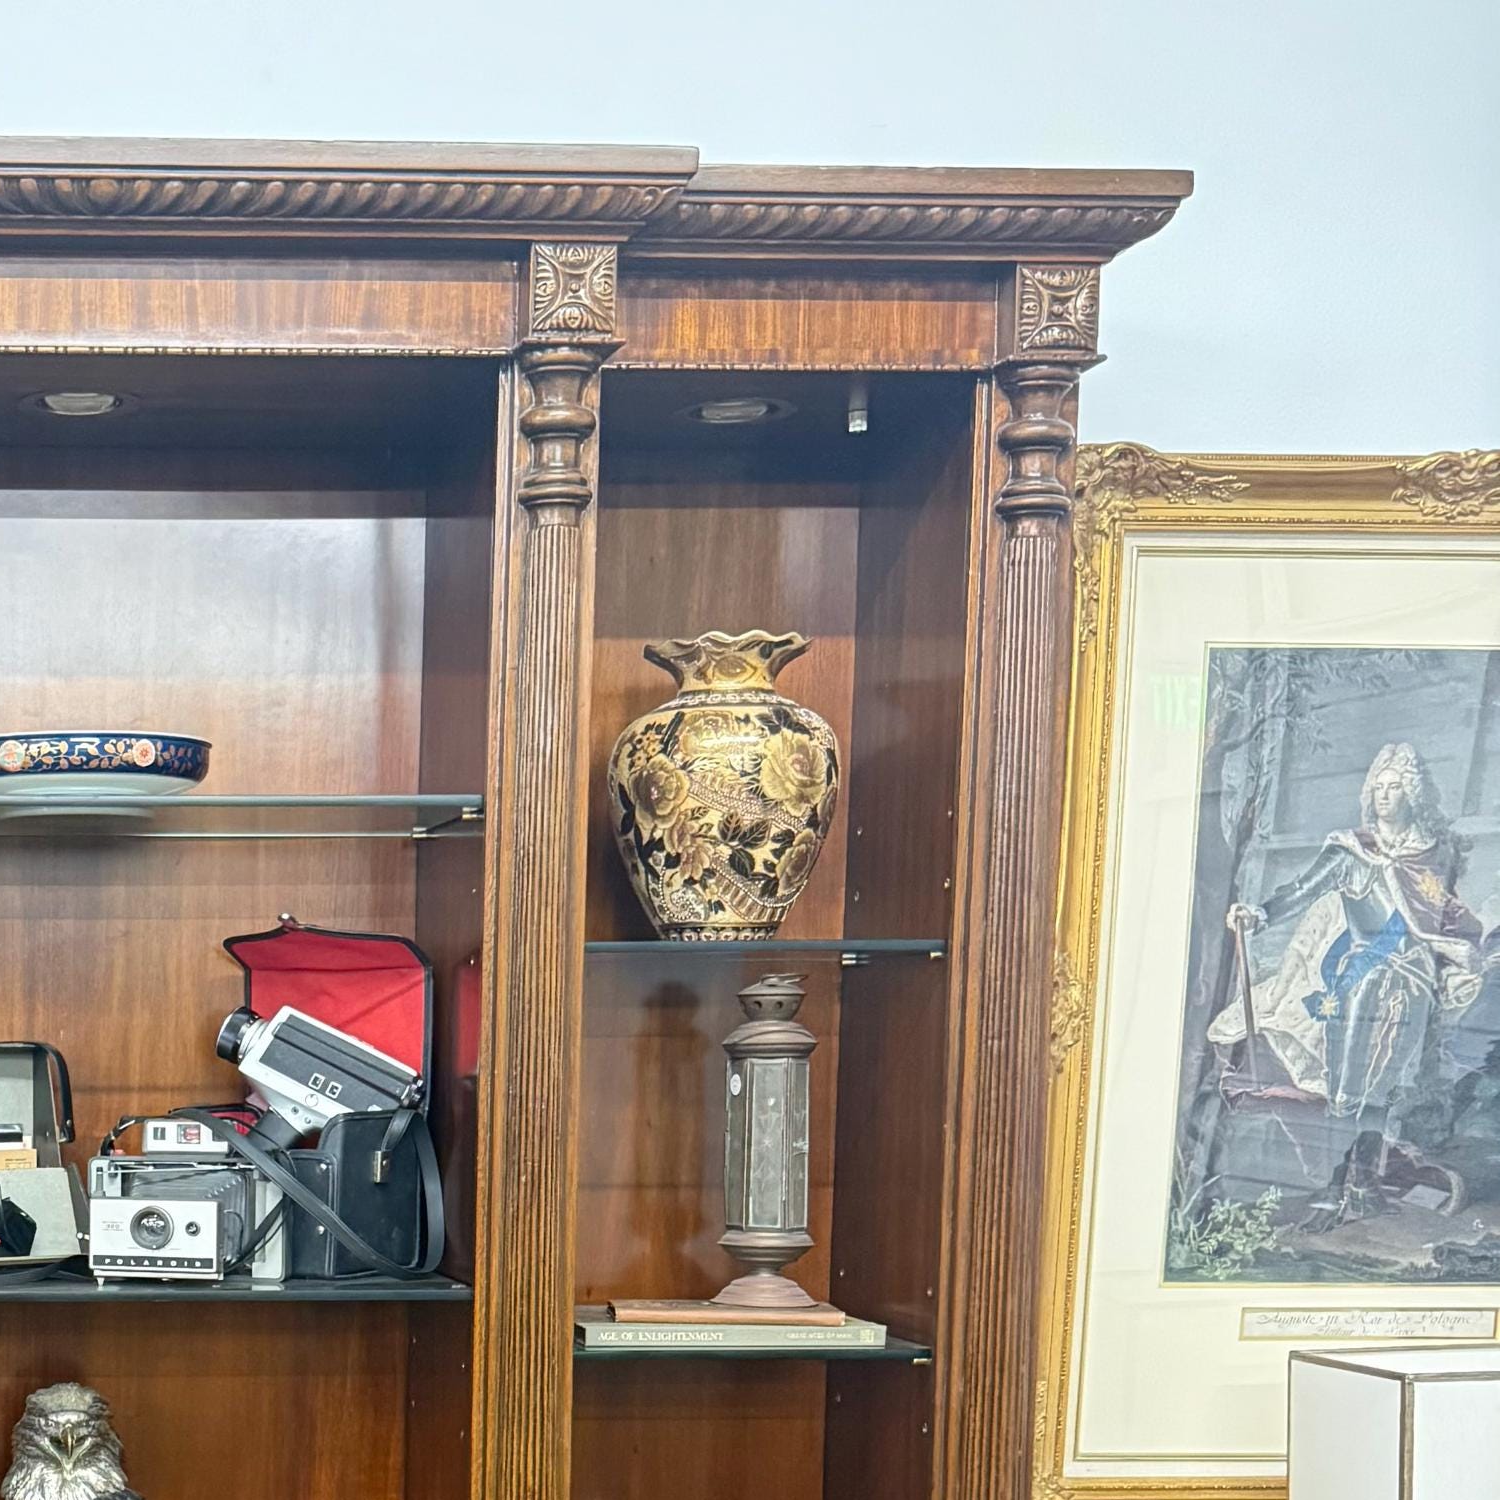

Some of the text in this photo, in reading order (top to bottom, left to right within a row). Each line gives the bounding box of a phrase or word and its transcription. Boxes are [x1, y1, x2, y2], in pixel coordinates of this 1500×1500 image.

[105, 1258, 201, 1267] POLAROID
[598, 1332, 618, 1340] AGE
[621, 1332, 635, 1340] OF
